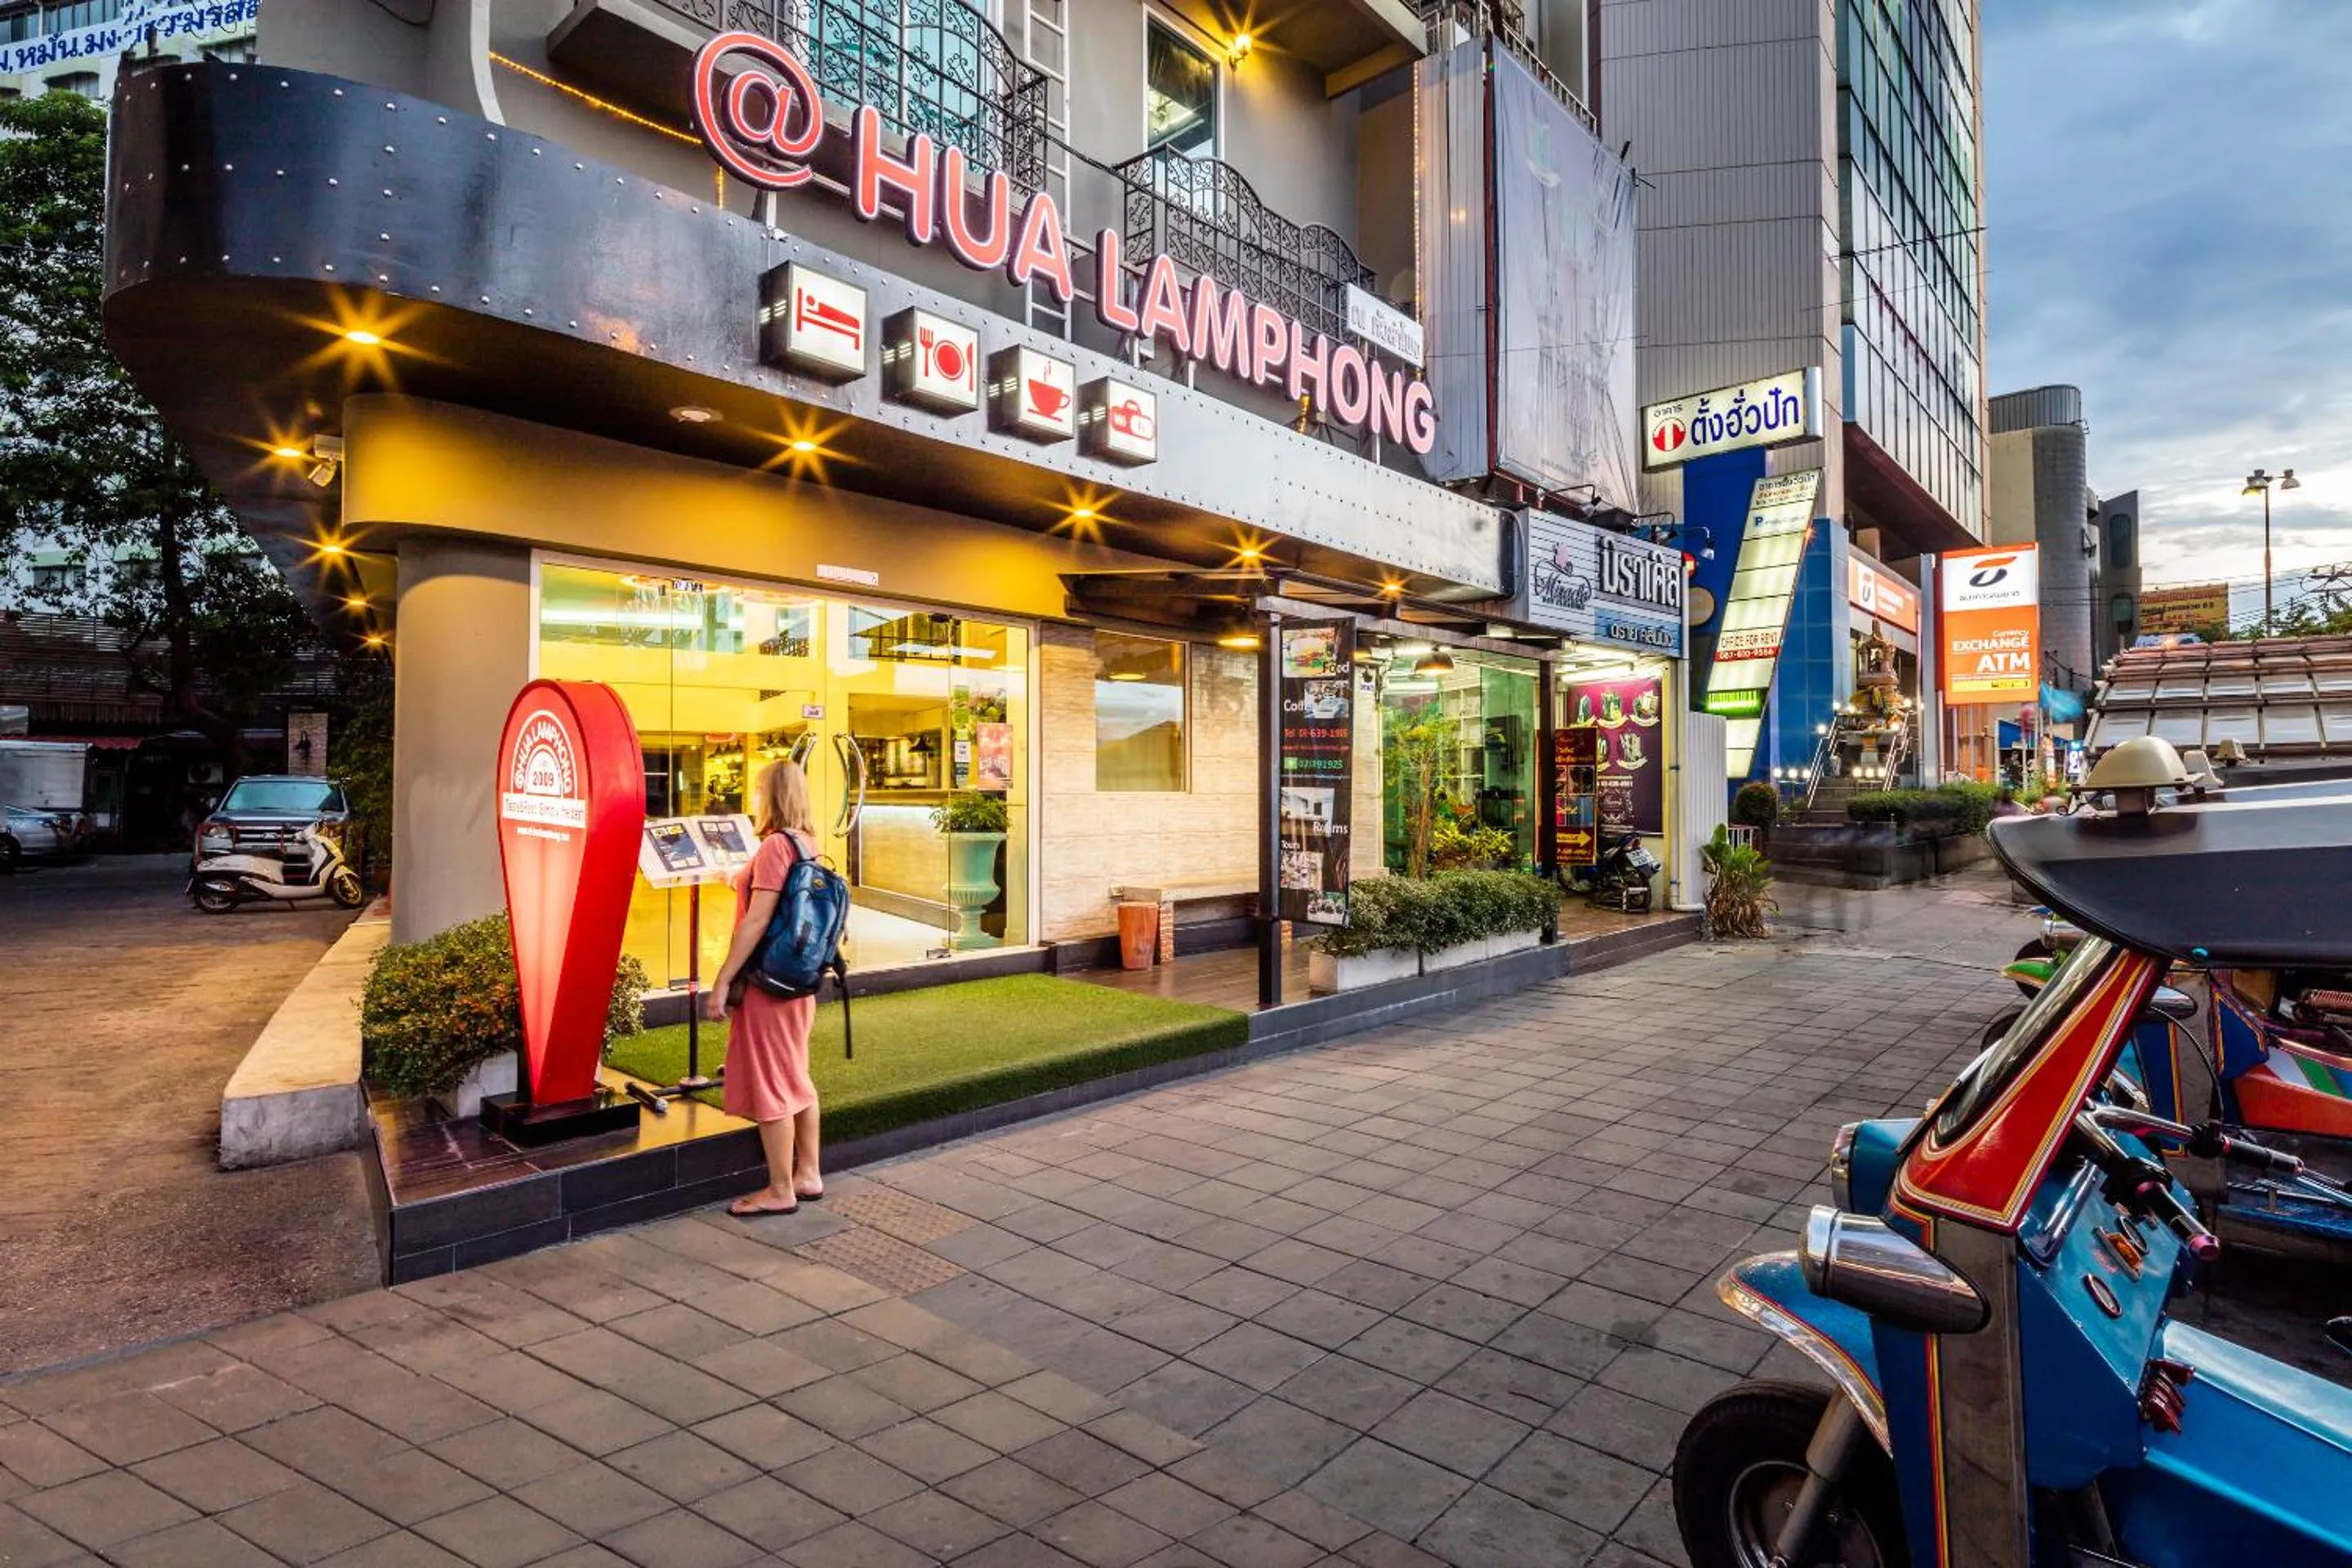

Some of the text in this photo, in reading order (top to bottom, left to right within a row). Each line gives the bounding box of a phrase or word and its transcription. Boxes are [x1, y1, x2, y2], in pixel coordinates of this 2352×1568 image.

[853, 105, 1074, 303] HUA
[1097, 228, 1438, 455] LAMPHONG
[1755, 516, 1763, 526] P
[1953, 636, 2030, 652] EXCHANGE
[1976, 653, 2031, 672] ATM
[532, 771, 555, 786] 2009
